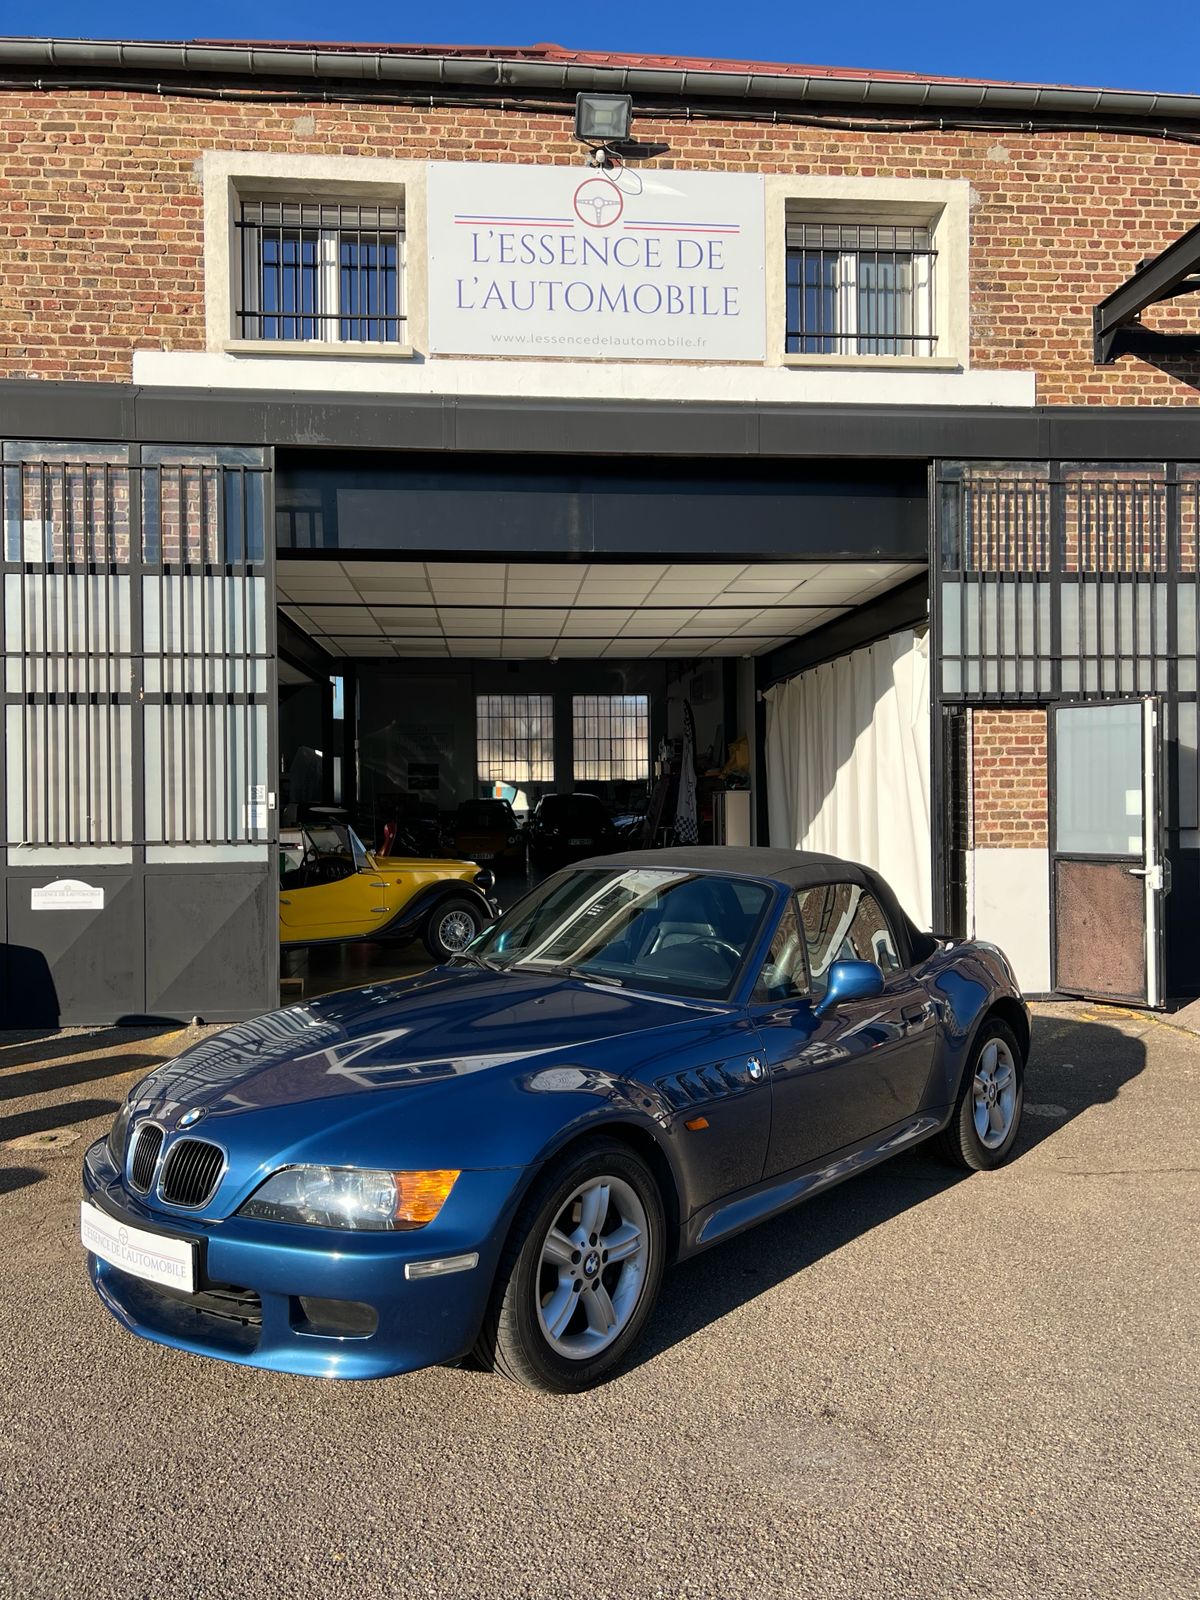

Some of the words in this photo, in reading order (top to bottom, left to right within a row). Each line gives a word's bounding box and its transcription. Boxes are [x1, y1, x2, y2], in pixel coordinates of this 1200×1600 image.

[471, 231, 663, 269] L'ESSENCE
[676, 239, 726, 270] DE
[456, 277, 741, 316] L'AUTOMOBILE
[491, 333, 708, 347] www.lessencedelautomobile.fr
[111, 1241, 121, 1256] DE
[121, 1246, 187, 1278] L'AUTOMOBILE
